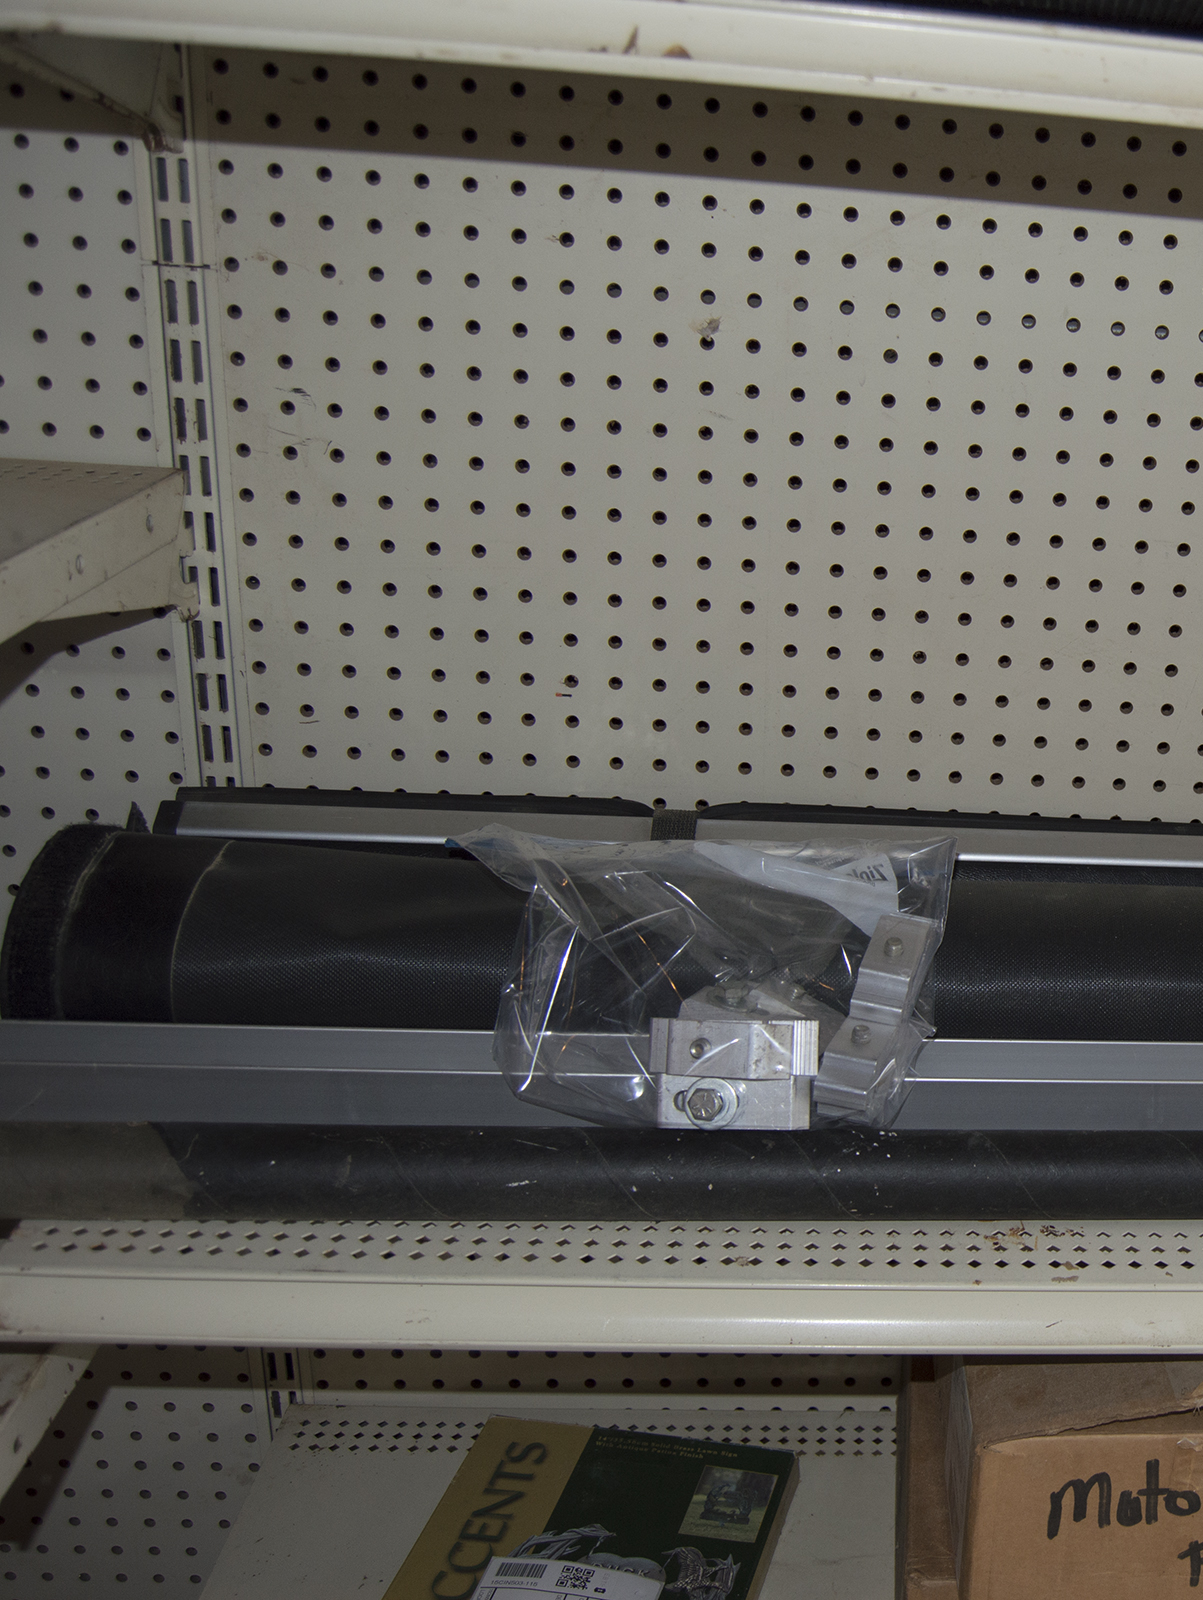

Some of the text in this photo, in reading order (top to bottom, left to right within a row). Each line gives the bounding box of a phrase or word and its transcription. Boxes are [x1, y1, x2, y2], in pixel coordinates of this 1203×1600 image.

[595, 1440, 614, 1448] With
[616, 1443, 649, 1452] Antique
[679, 1451, 704, 1459] Finish
[720, 1450, 738, 1458] Sign
